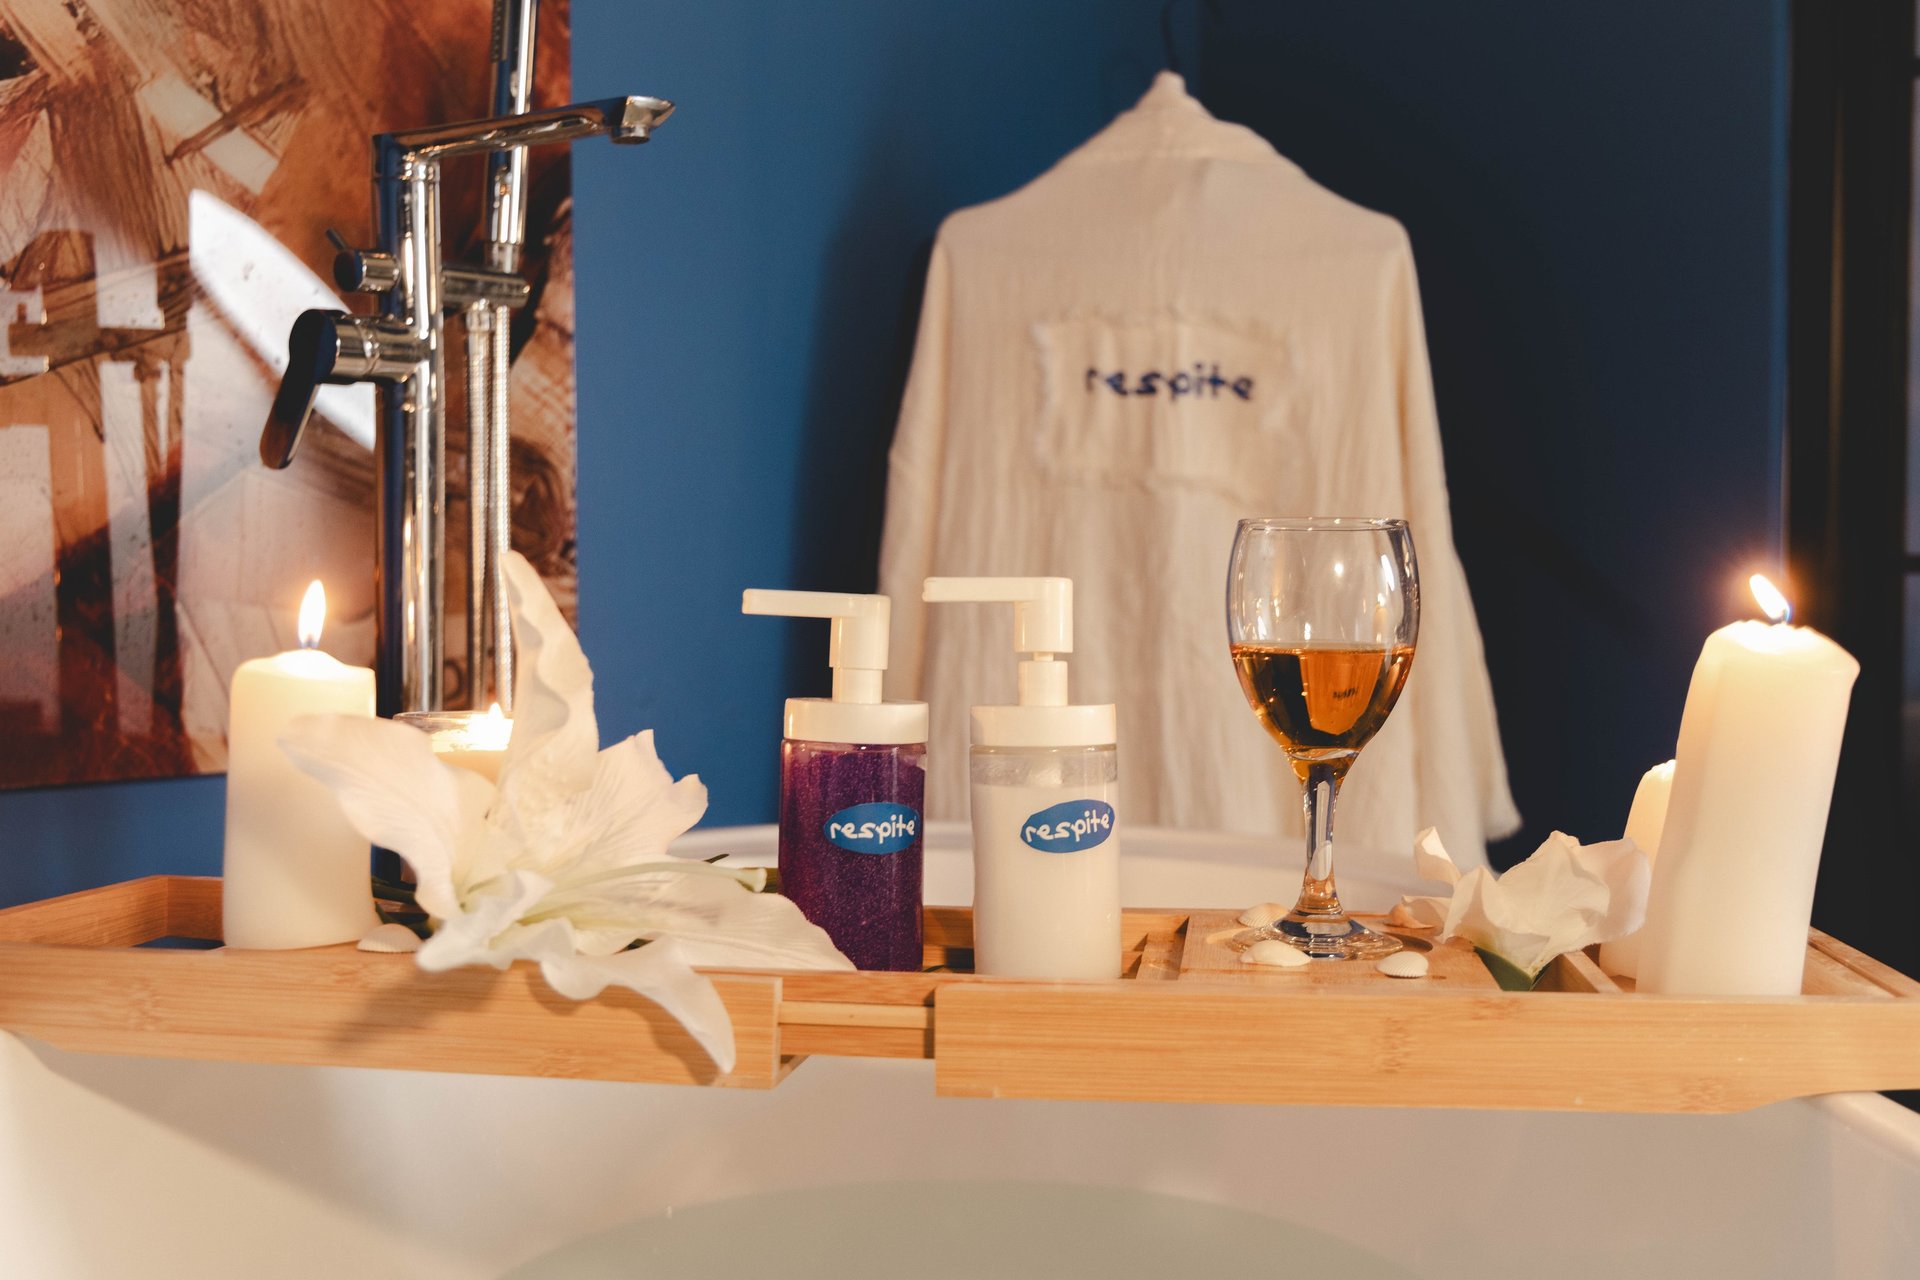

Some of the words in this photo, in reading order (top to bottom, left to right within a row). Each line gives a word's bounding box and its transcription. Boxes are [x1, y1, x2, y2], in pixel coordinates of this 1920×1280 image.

[1086, 363, 1254, 403] respite
[830, 814, 915, 845] respite
[1025, 809, 1110, 842] respite
